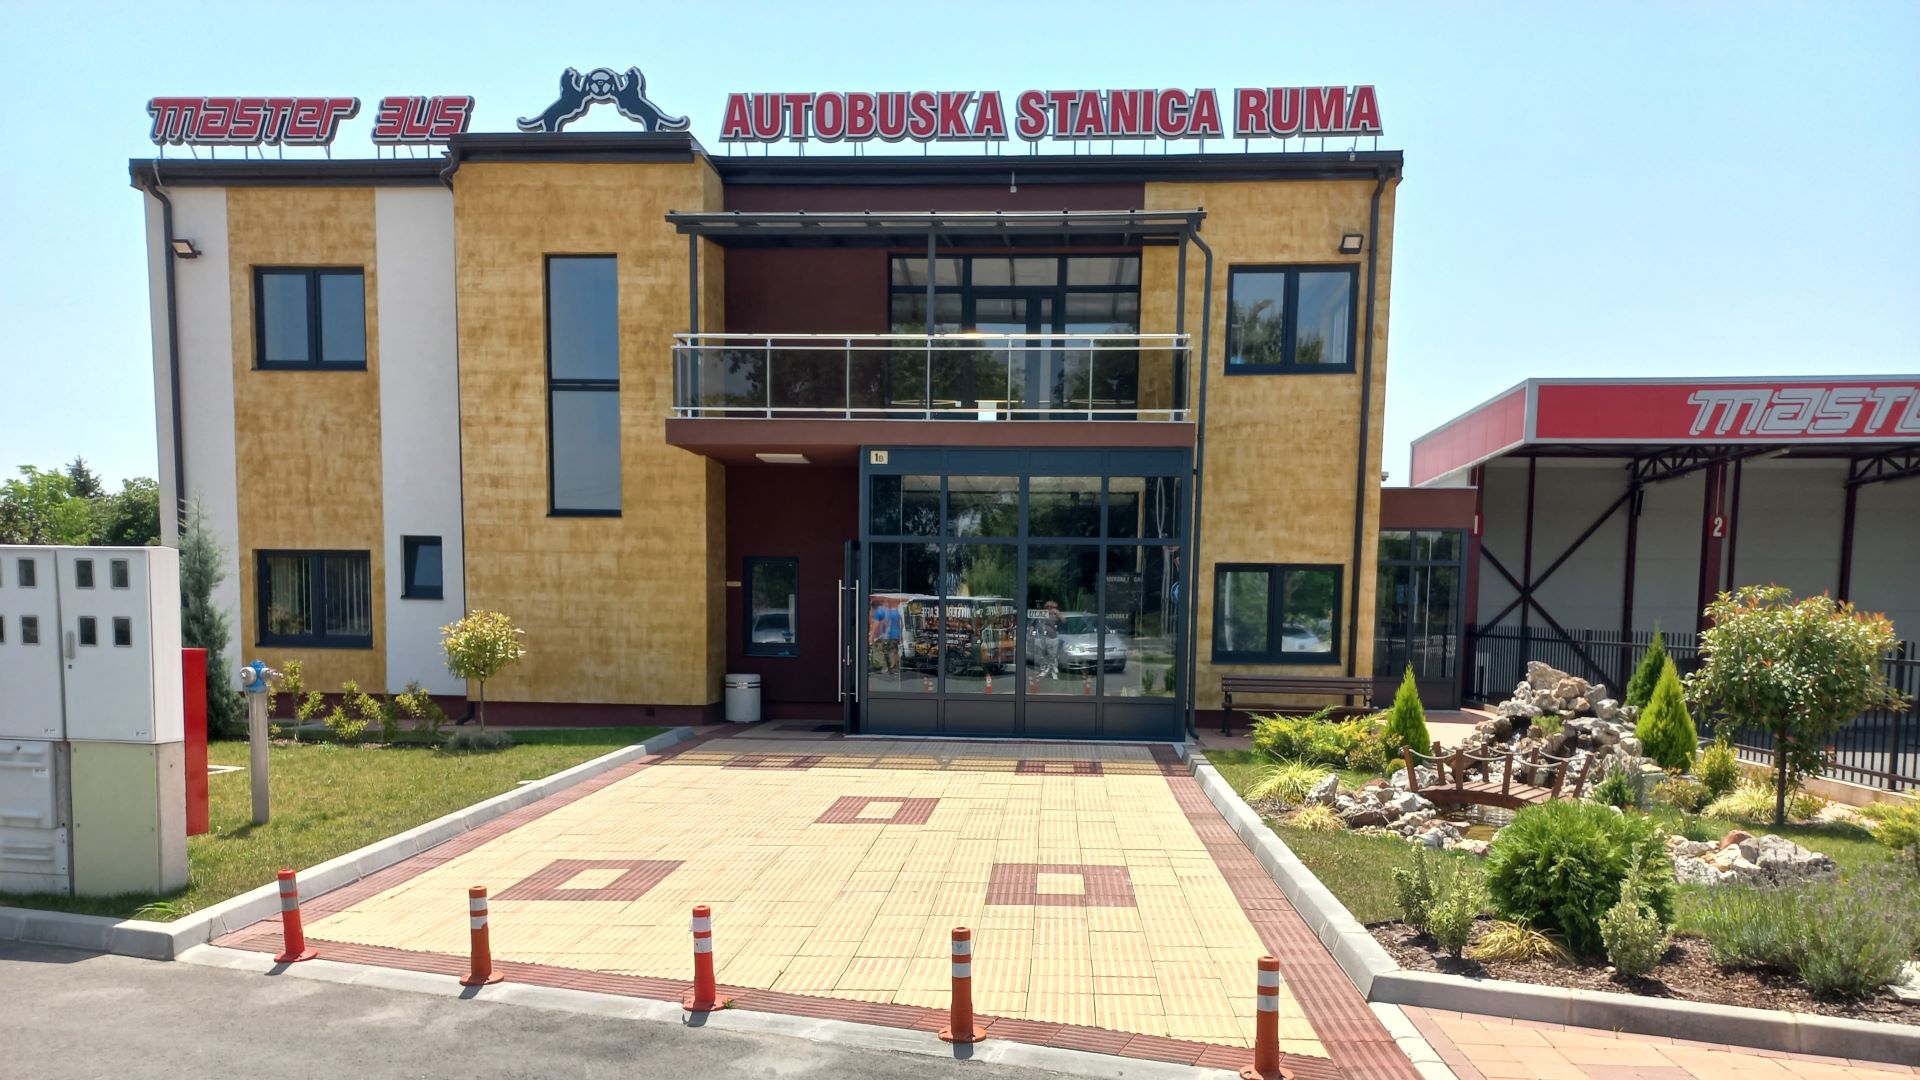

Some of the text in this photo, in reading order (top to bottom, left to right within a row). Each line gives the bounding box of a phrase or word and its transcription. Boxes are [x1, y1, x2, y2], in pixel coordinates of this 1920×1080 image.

[719, 85, 1384, 143] AUTOBUSKA STANICA RUMA
[1712, 516, 1723, 537] 2
